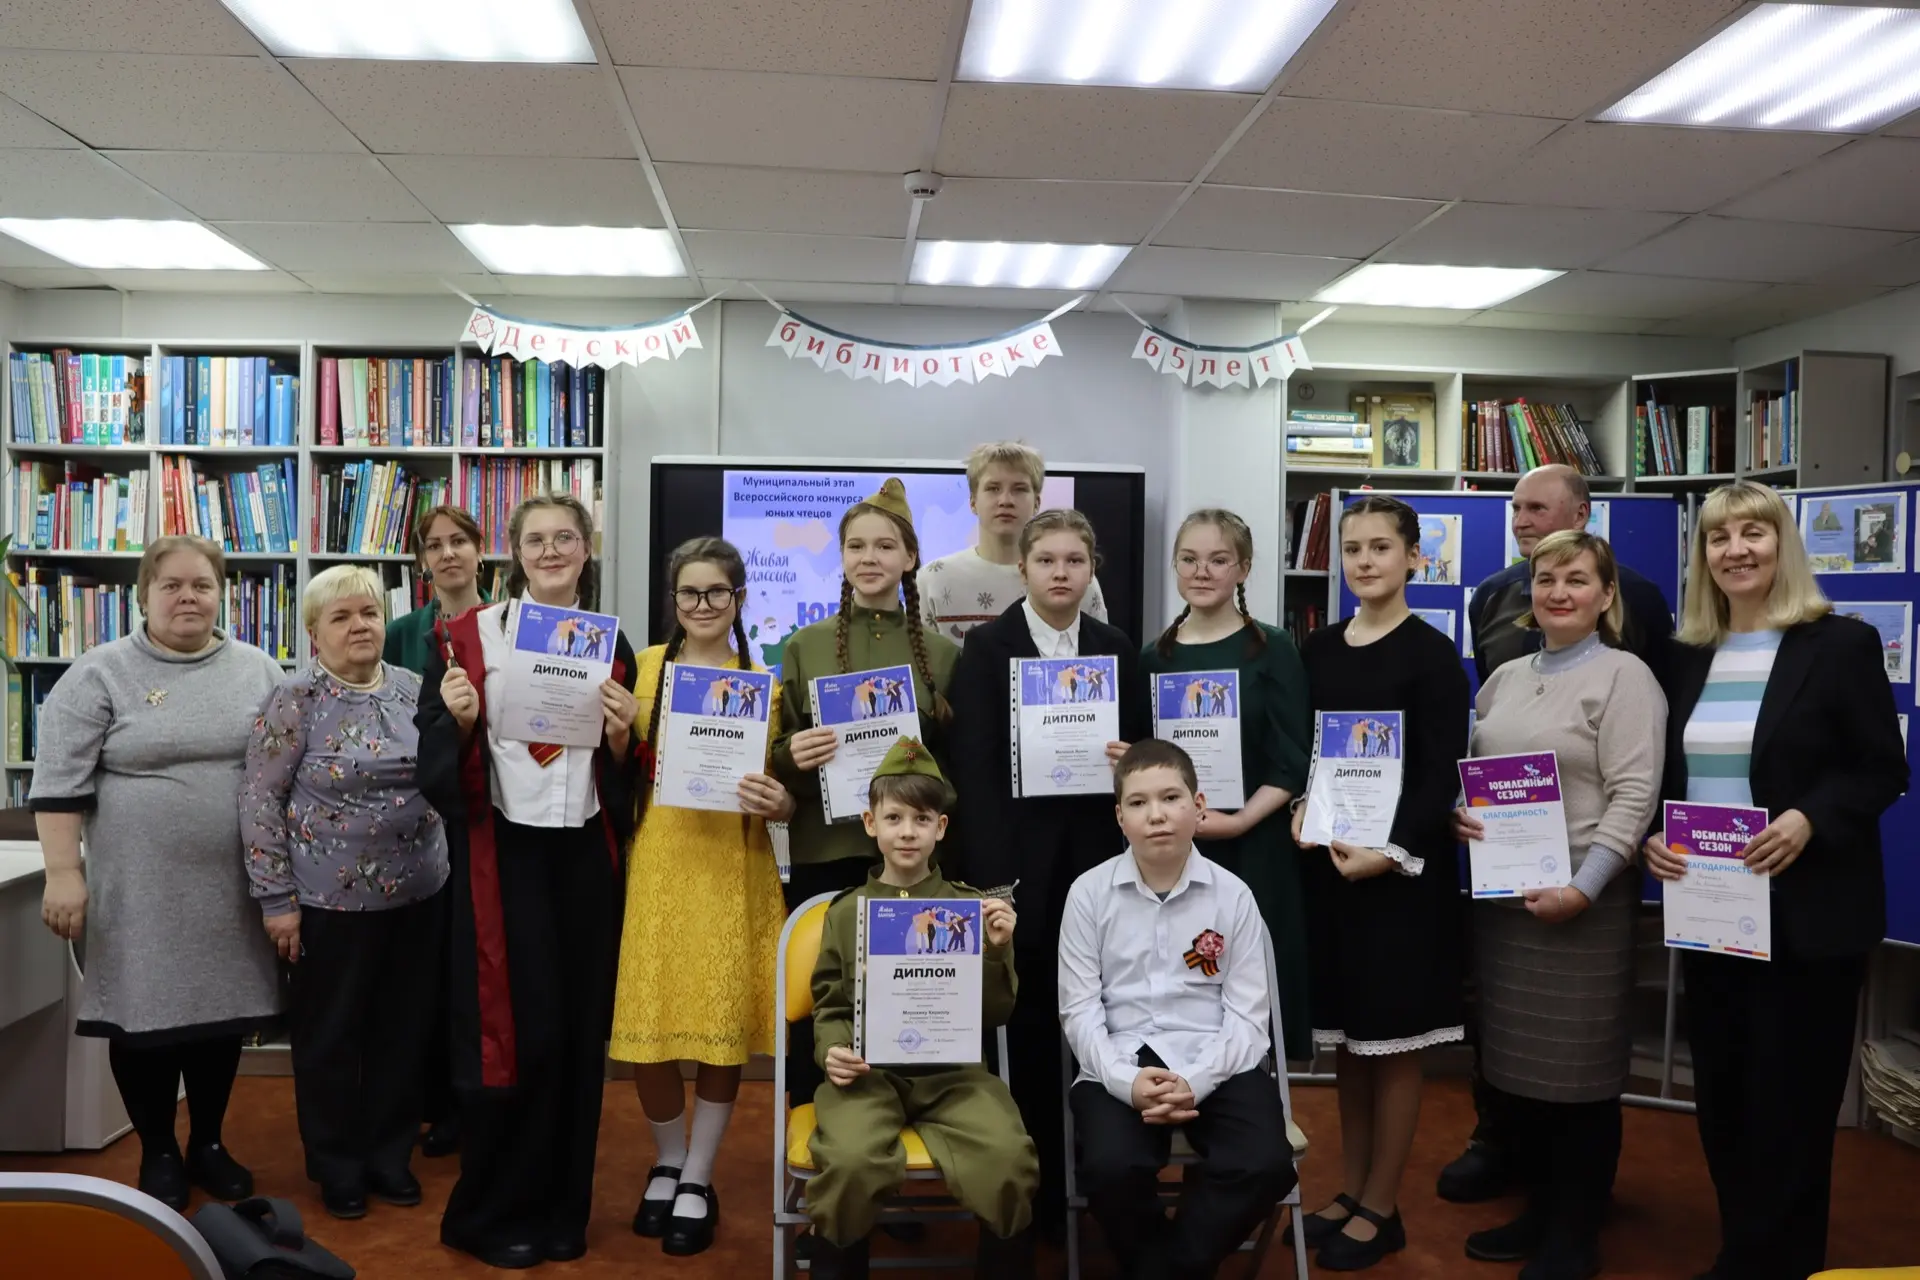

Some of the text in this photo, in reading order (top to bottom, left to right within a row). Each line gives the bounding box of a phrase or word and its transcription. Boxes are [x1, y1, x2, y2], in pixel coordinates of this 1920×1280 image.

[500, 321, 692, 356] Детской
[780, 321, 1049, 374] библиотеке
[743, 476, 855, 488] Муниципальный этап
[734, 491, 863, 504] Всероссийского конкурса
[765, 509, 832, 519] юных чтецов
[746, 547, 789, 567] Живая
[533, 664, 587, 680] ДИПЛОМ
[1043, 713, 1096, 725] ДИПЛОМ
[690, 725, 744, 739] ДИПЛОМ
[845, 726, 898, 744] ДИПЛОМ
[1172, 729, 1218, 740] ДИПЛОМ
[1335, 768, 1381, 778] ДИПЛОМ
[1489, 775, 1553, 791] ЮБИЛЕЙНЫЙ
[1497, 790, 1527, 800] СЕЗОН
[1483, 808, 1548, 820] БЛАГОДАРНОСТЬ
[1699, 842, 1732, 853] СЕЗОН
[1686, 861, 1752, 875] ЛАГОДАРНОСТЬ
[893, 968, 955, 980] ДИПЛОМ
